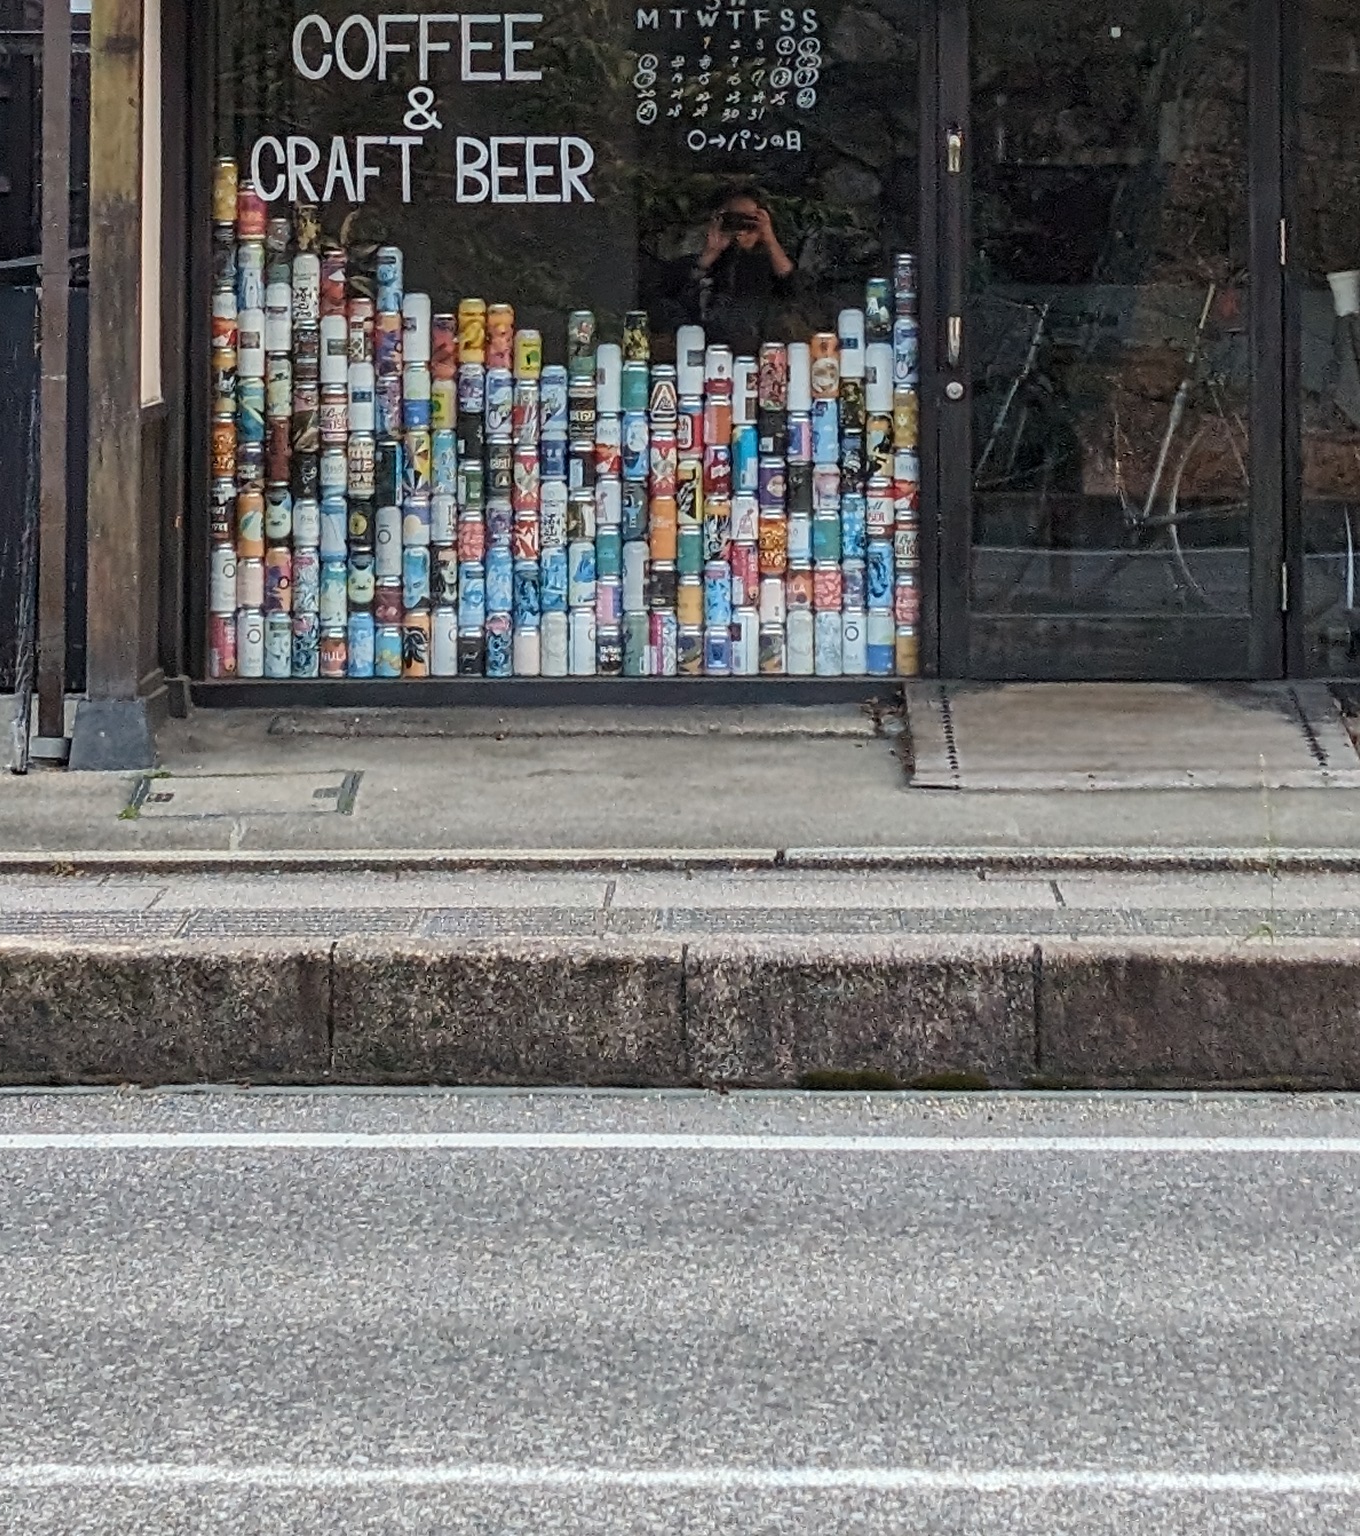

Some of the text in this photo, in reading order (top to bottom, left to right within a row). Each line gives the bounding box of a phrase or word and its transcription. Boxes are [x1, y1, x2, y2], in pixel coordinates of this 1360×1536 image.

[292, 14, 542, 81] COFFEE
[636, 7, 818, 33] M T W T F S S
[403, 86, 442, 131] &
[249, 135, 595, 202] CRAFT BEER
